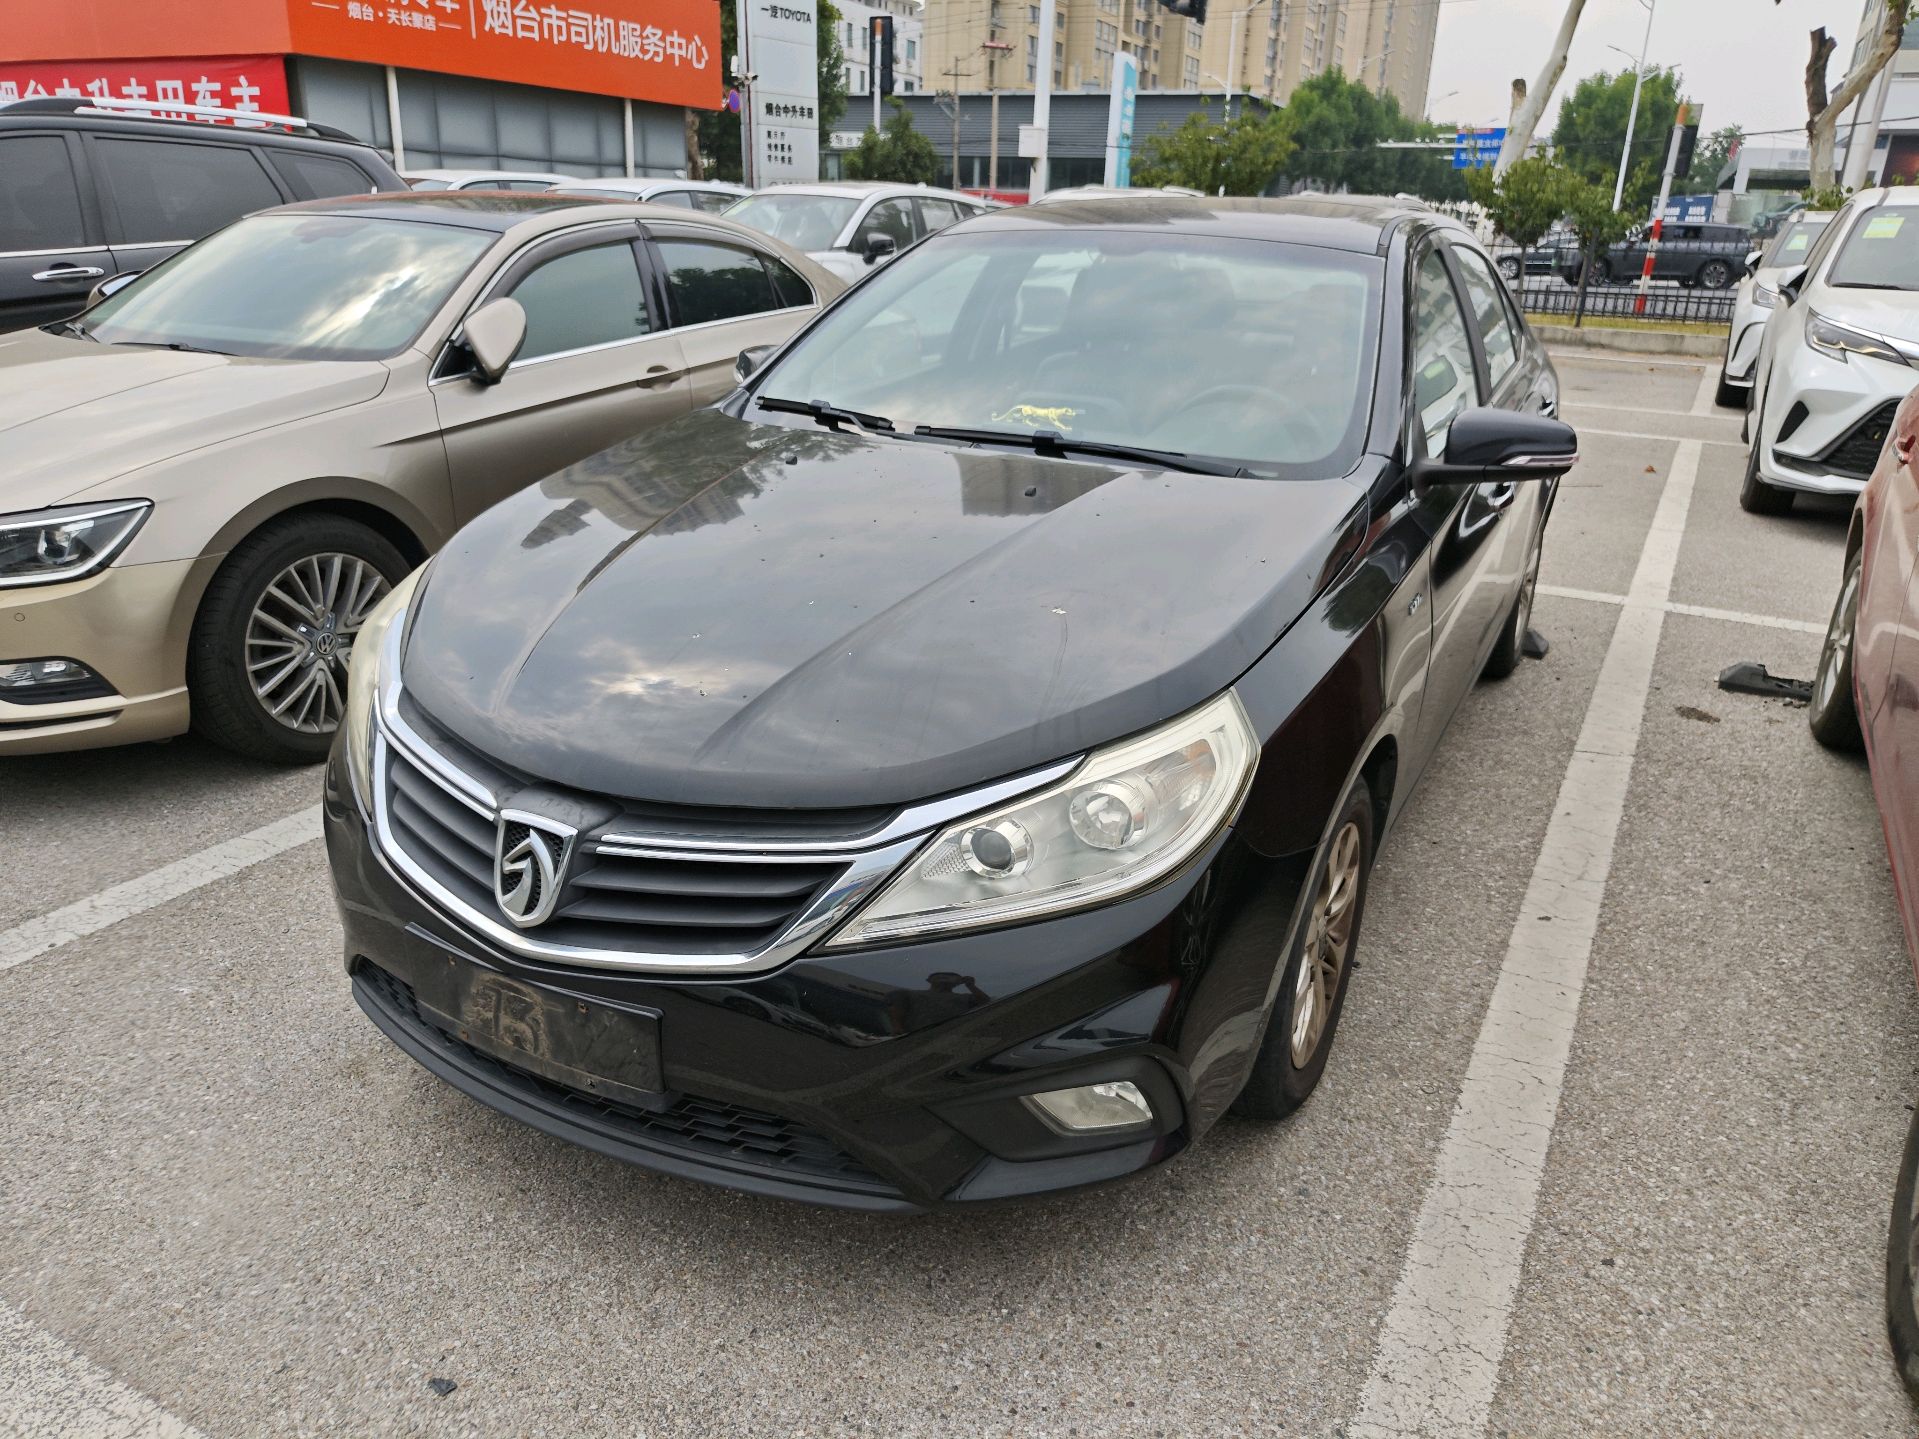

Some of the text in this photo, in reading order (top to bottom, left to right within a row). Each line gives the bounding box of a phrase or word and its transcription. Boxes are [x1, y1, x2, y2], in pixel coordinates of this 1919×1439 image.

[483, 0, 709, 70] 烟台市司机服务中心
